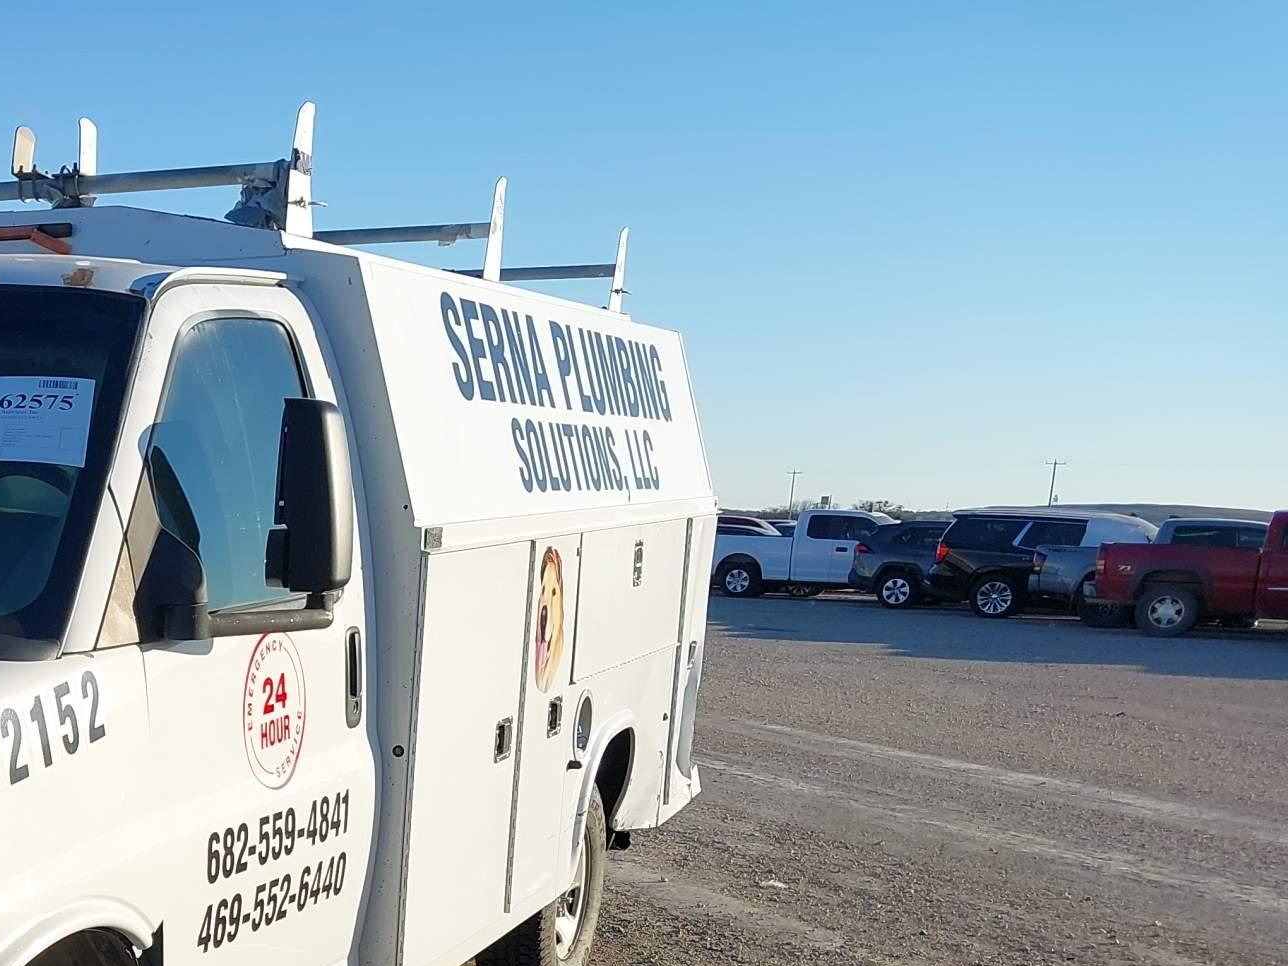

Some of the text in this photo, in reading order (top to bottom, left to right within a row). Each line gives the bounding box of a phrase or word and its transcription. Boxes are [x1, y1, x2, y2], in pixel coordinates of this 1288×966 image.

[440, 291, 673, 422] SERNA PLUMBING
[511, 417, 660, 493] SOLUTIONS, LLC
[247, 639, 284, 731] EMERGENCY
[262, 672, 288, 716] 24
[260, 714, 291, 750] HOUR
[275, 710, 303, 778] SERVICE
[207, 788, 351, 885] 682-559-4841
[197, 851, 347, 954] 469-552-6440
